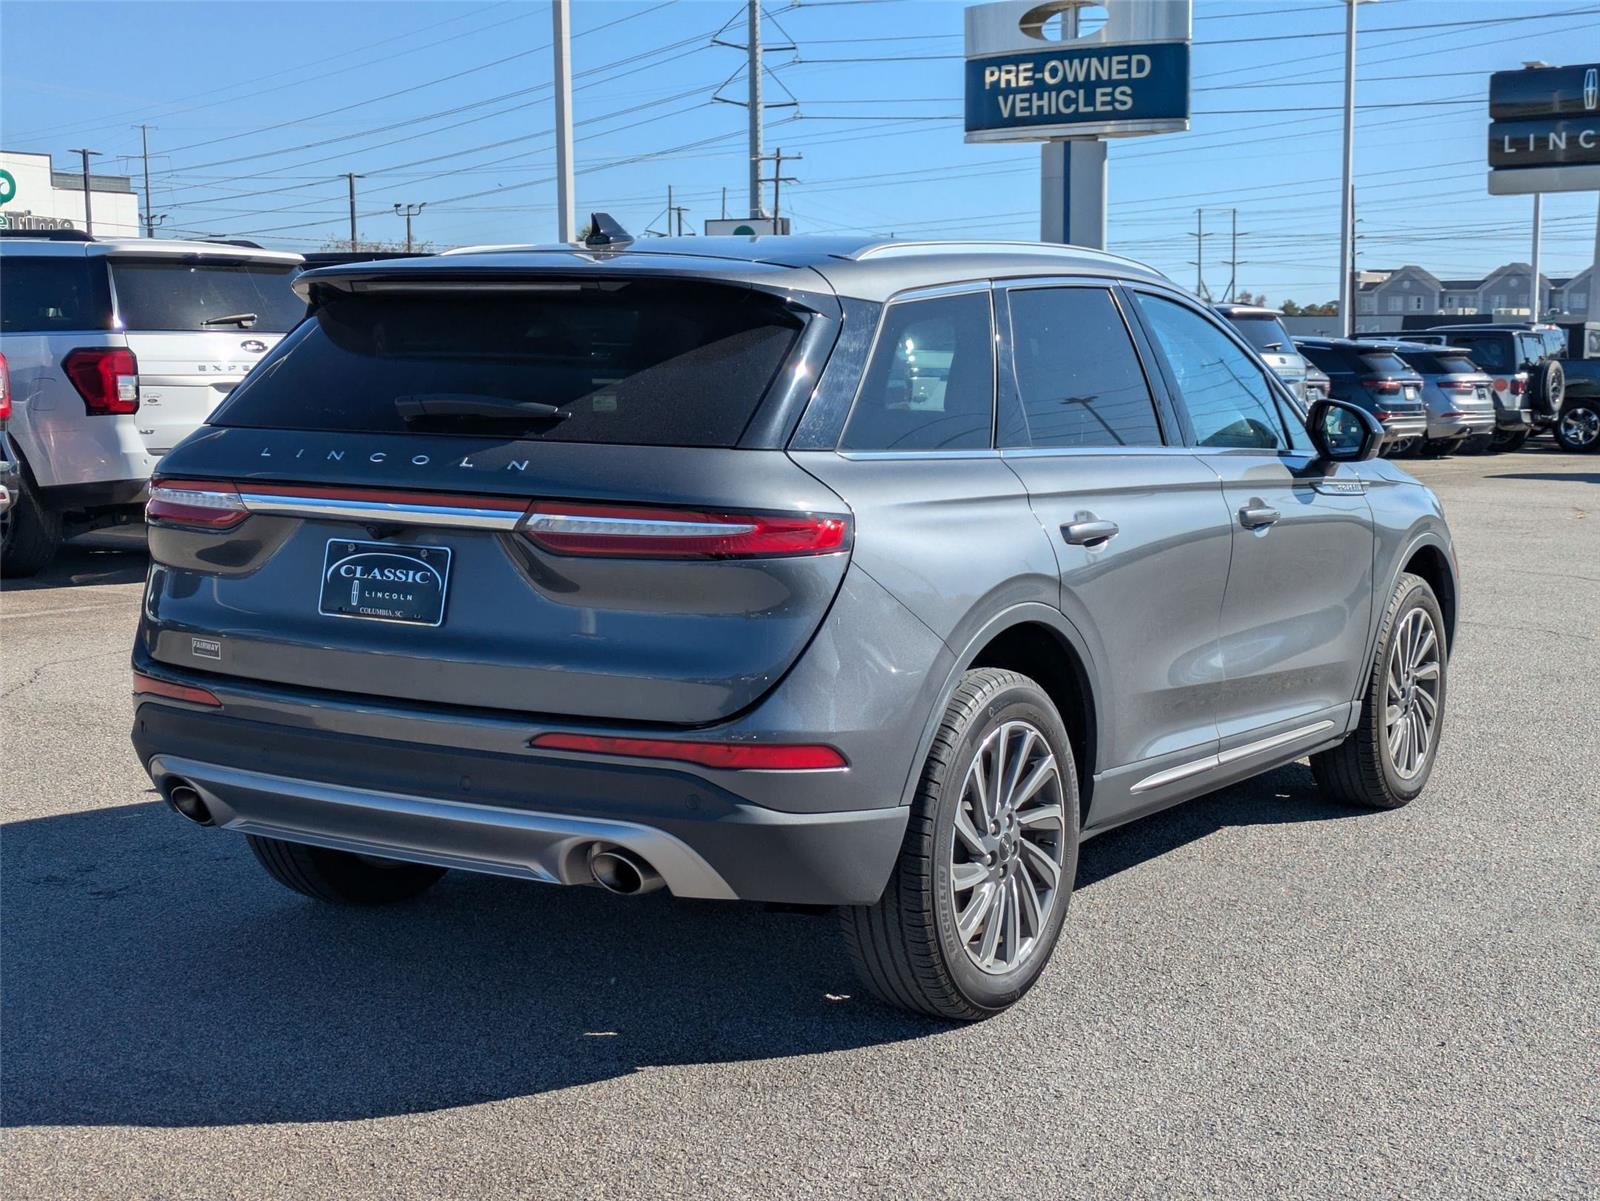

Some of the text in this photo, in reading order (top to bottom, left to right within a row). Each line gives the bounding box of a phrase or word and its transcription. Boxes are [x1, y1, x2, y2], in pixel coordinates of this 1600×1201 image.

[984, 54, 1151, 89] PRE-OWNED
[998, 86, 1133, 118] VEHICLES
[1504, 130, 1597, 153] LINC
[260, 447, 529, 471] LINCOLN
[340, 564, 430, 584] CLASSIC
[365, 590, 413, 601] LINCOLN
[939, 867, 956, 954] MICHELIN
